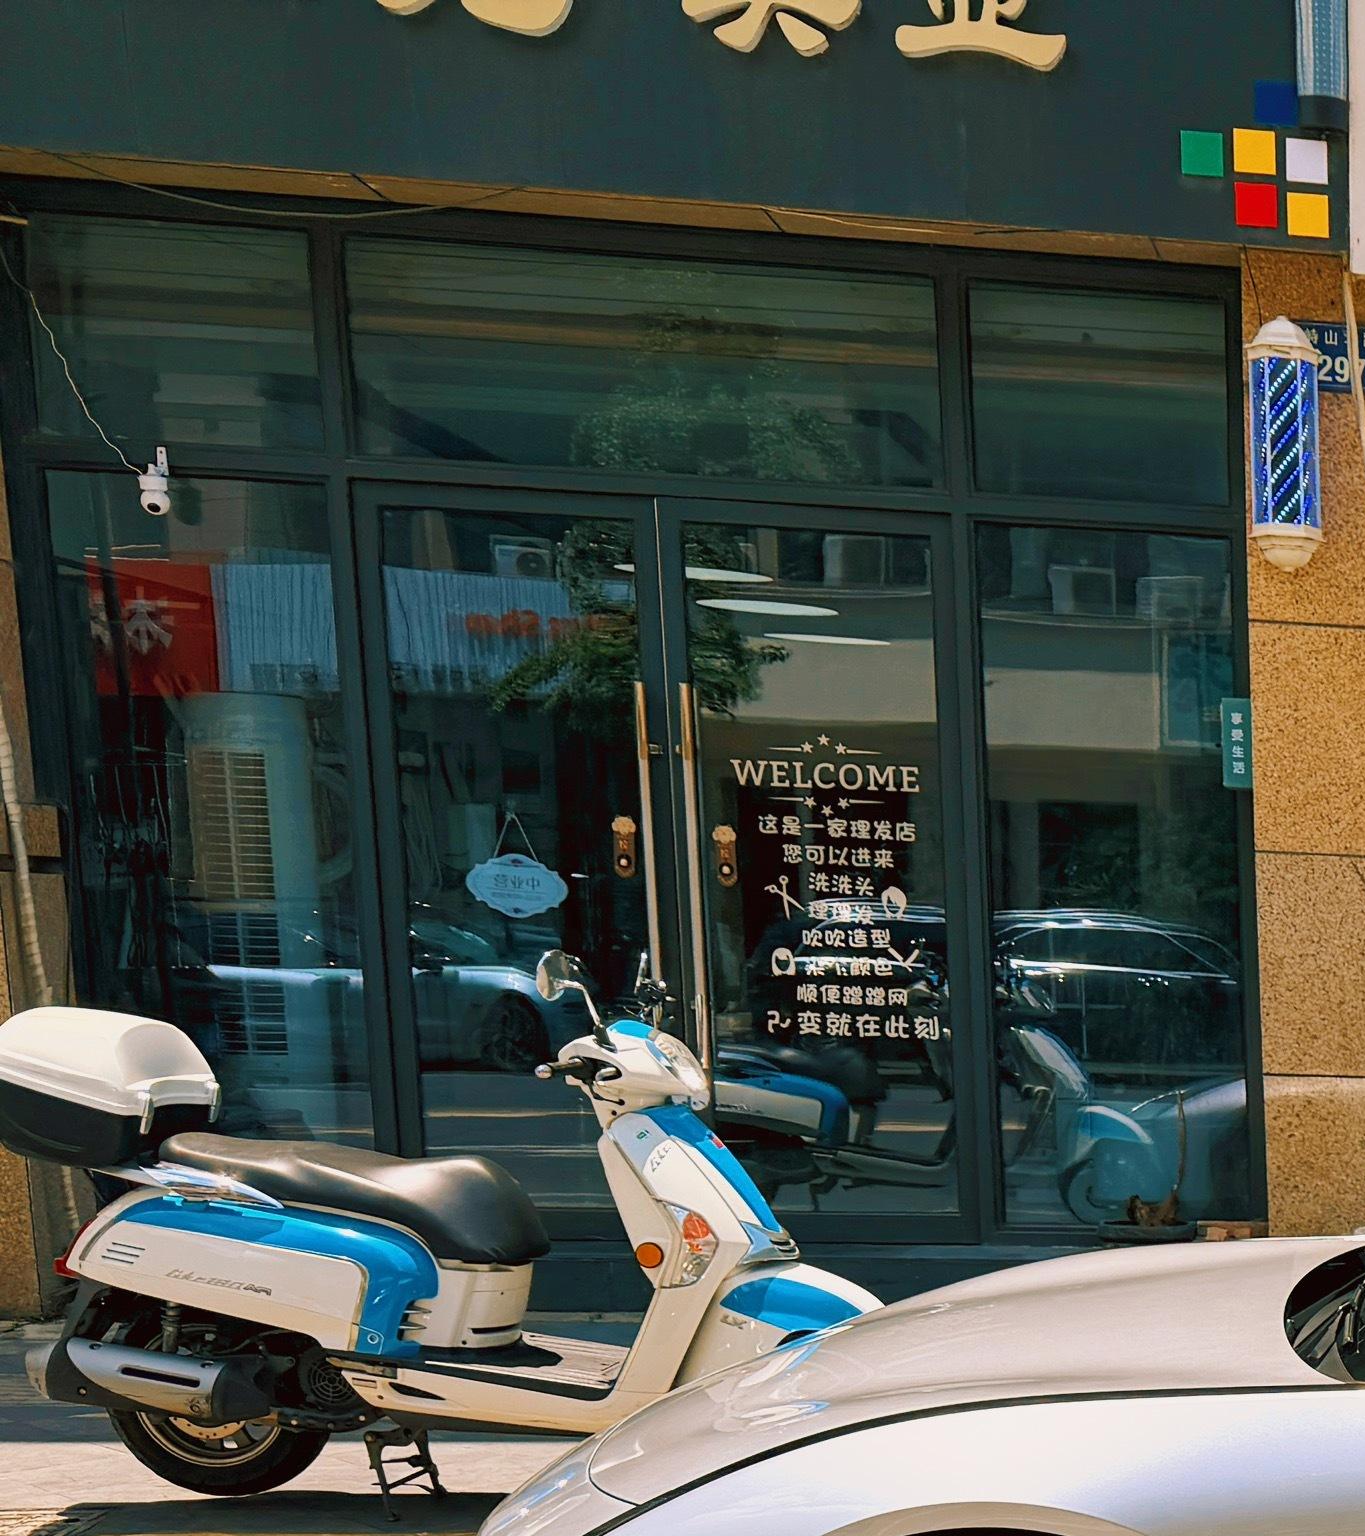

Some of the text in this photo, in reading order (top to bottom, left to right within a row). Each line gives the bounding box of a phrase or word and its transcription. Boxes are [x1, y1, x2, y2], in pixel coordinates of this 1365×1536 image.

[730, 759, 920, 793] WELCOME
[758, 814, 916, 842] 这是一家理发店
[782, 844, 894, 869] 您可以进来
[494, 873, 540, 890] 营业中
[808, 872, 874, 896] 洗洗头
[808, 901, 875, 925] 理理发
[802, 928, 890, 949] 吹吹造型
[797, 985, 908, 1007] 顺便蹭蹭网
